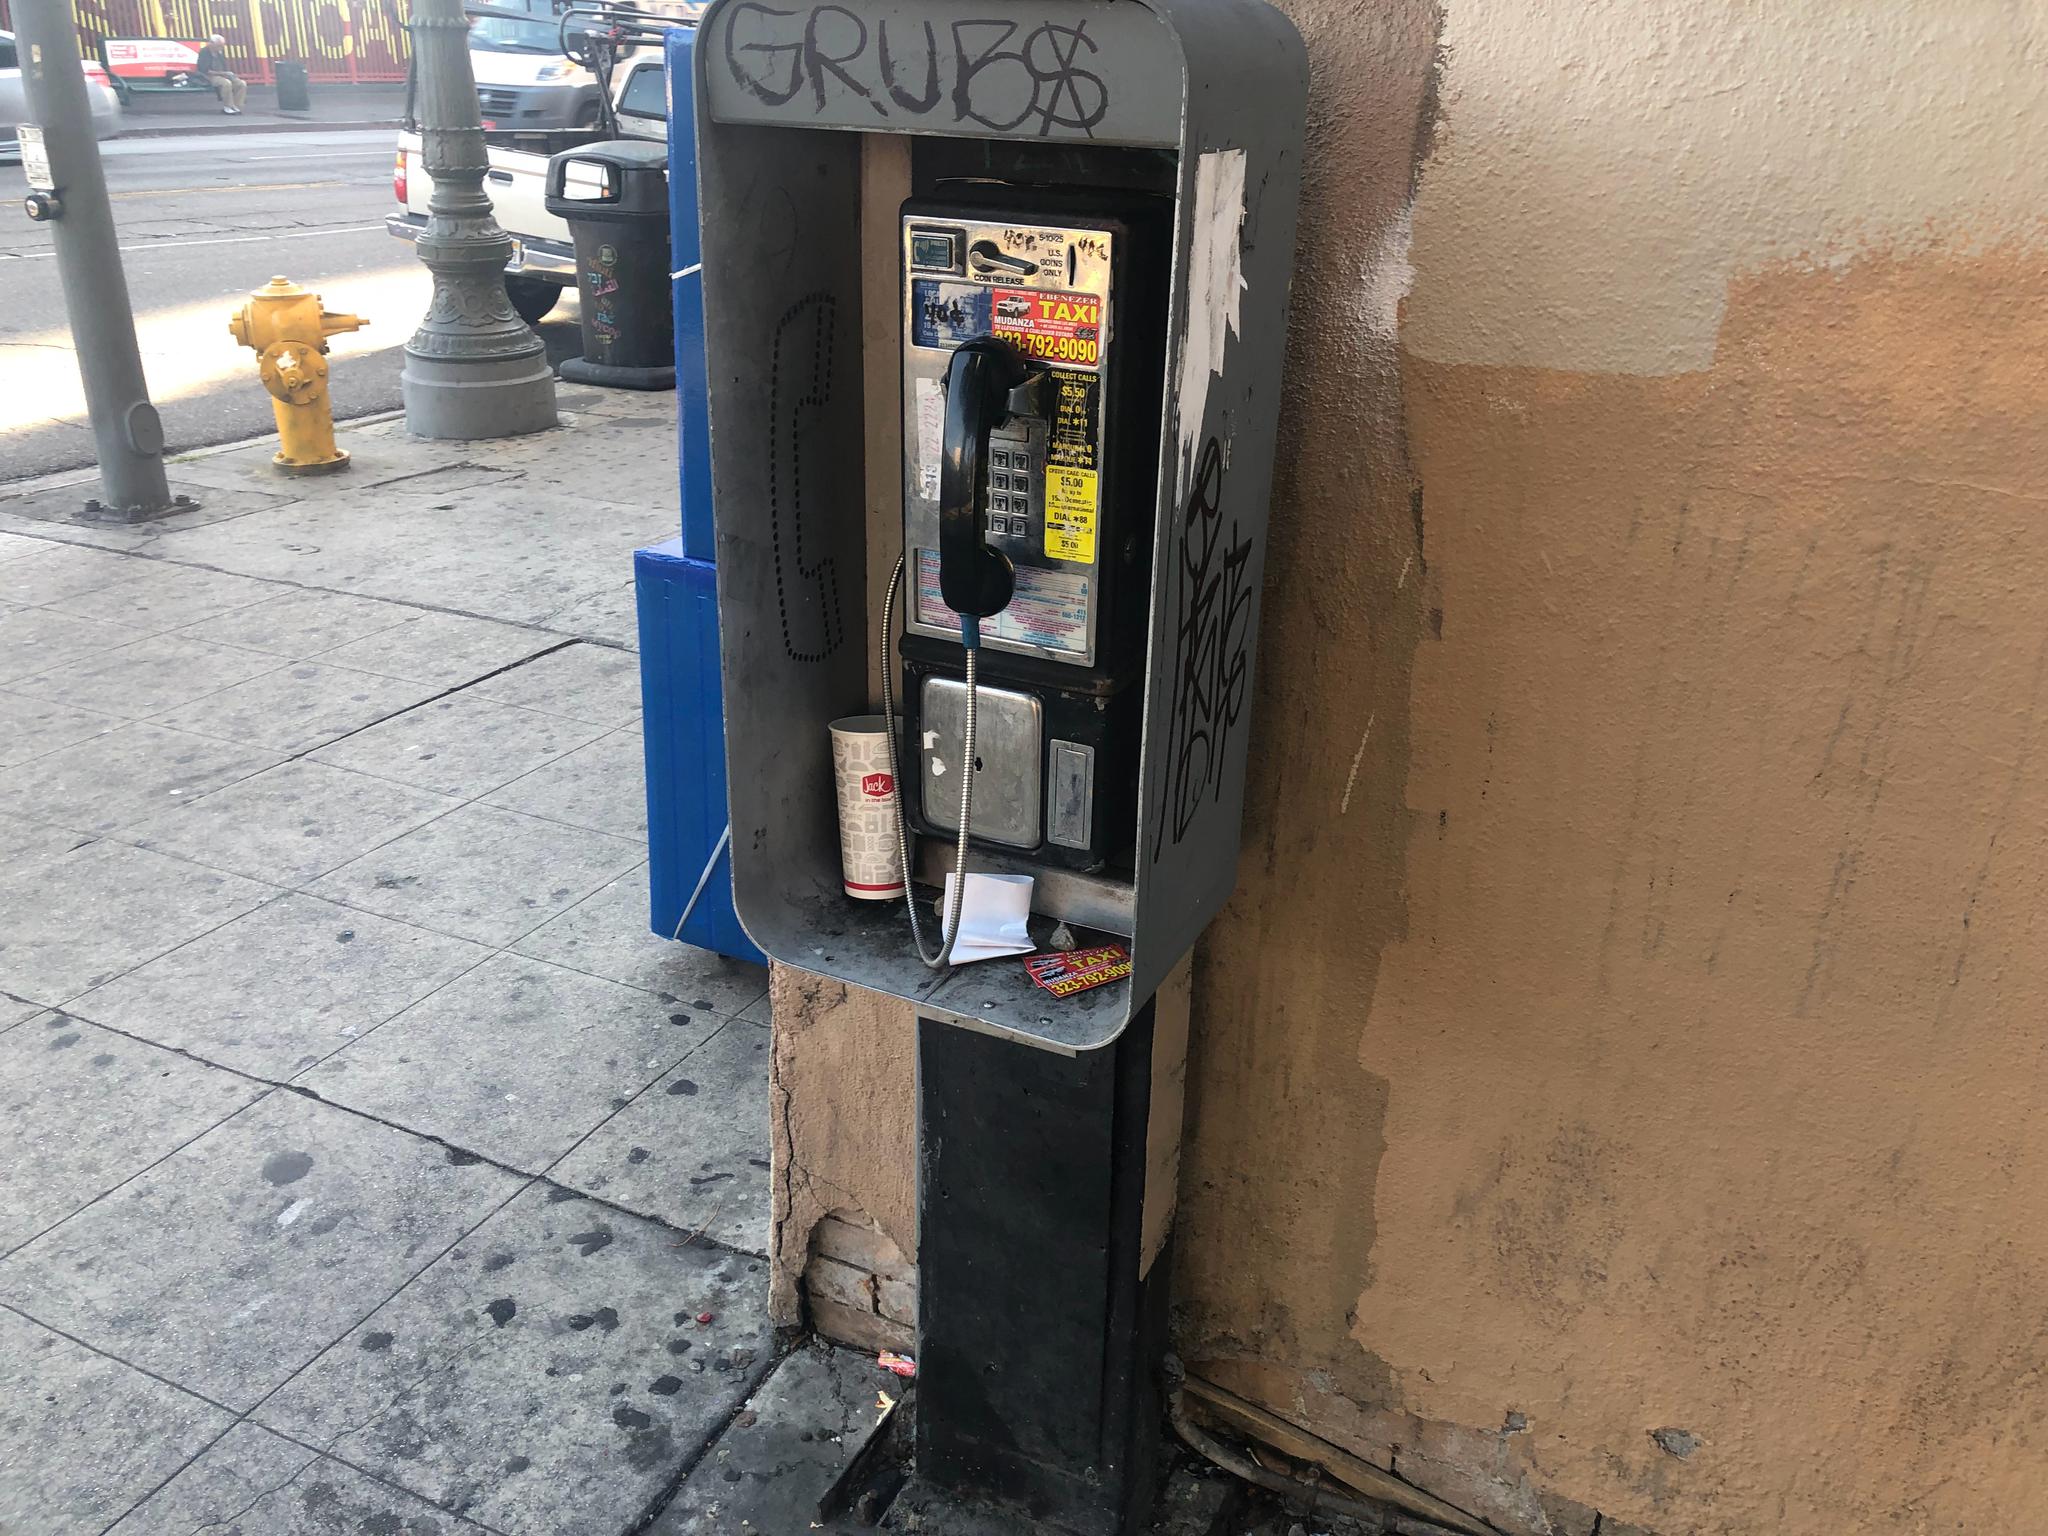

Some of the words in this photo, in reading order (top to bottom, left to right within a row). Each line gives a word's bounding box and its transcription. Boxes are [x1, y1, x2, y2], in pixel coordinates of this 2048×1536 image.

[1040, 258, 1063, 267] COINS
[974, 274, 991, 283] COIN
[992, 276, 1024, 286] RELEASE
[1039, 293, 1097, 304] EBENEZER
[1039, 301, 1097, 323] TAXI
[994, 316, 1035, 328] MUDANZA
[1051, 371, 1077, 380] COLLECT
[1077, 373, 1097, 383] CALLS
[1060, 476, 1083, 488] $5.00
[1054, 512, 1071, 521] DIAL
[863, 776, 893, 793] Jack
[1070, 949, 1122, 969] TAXI
